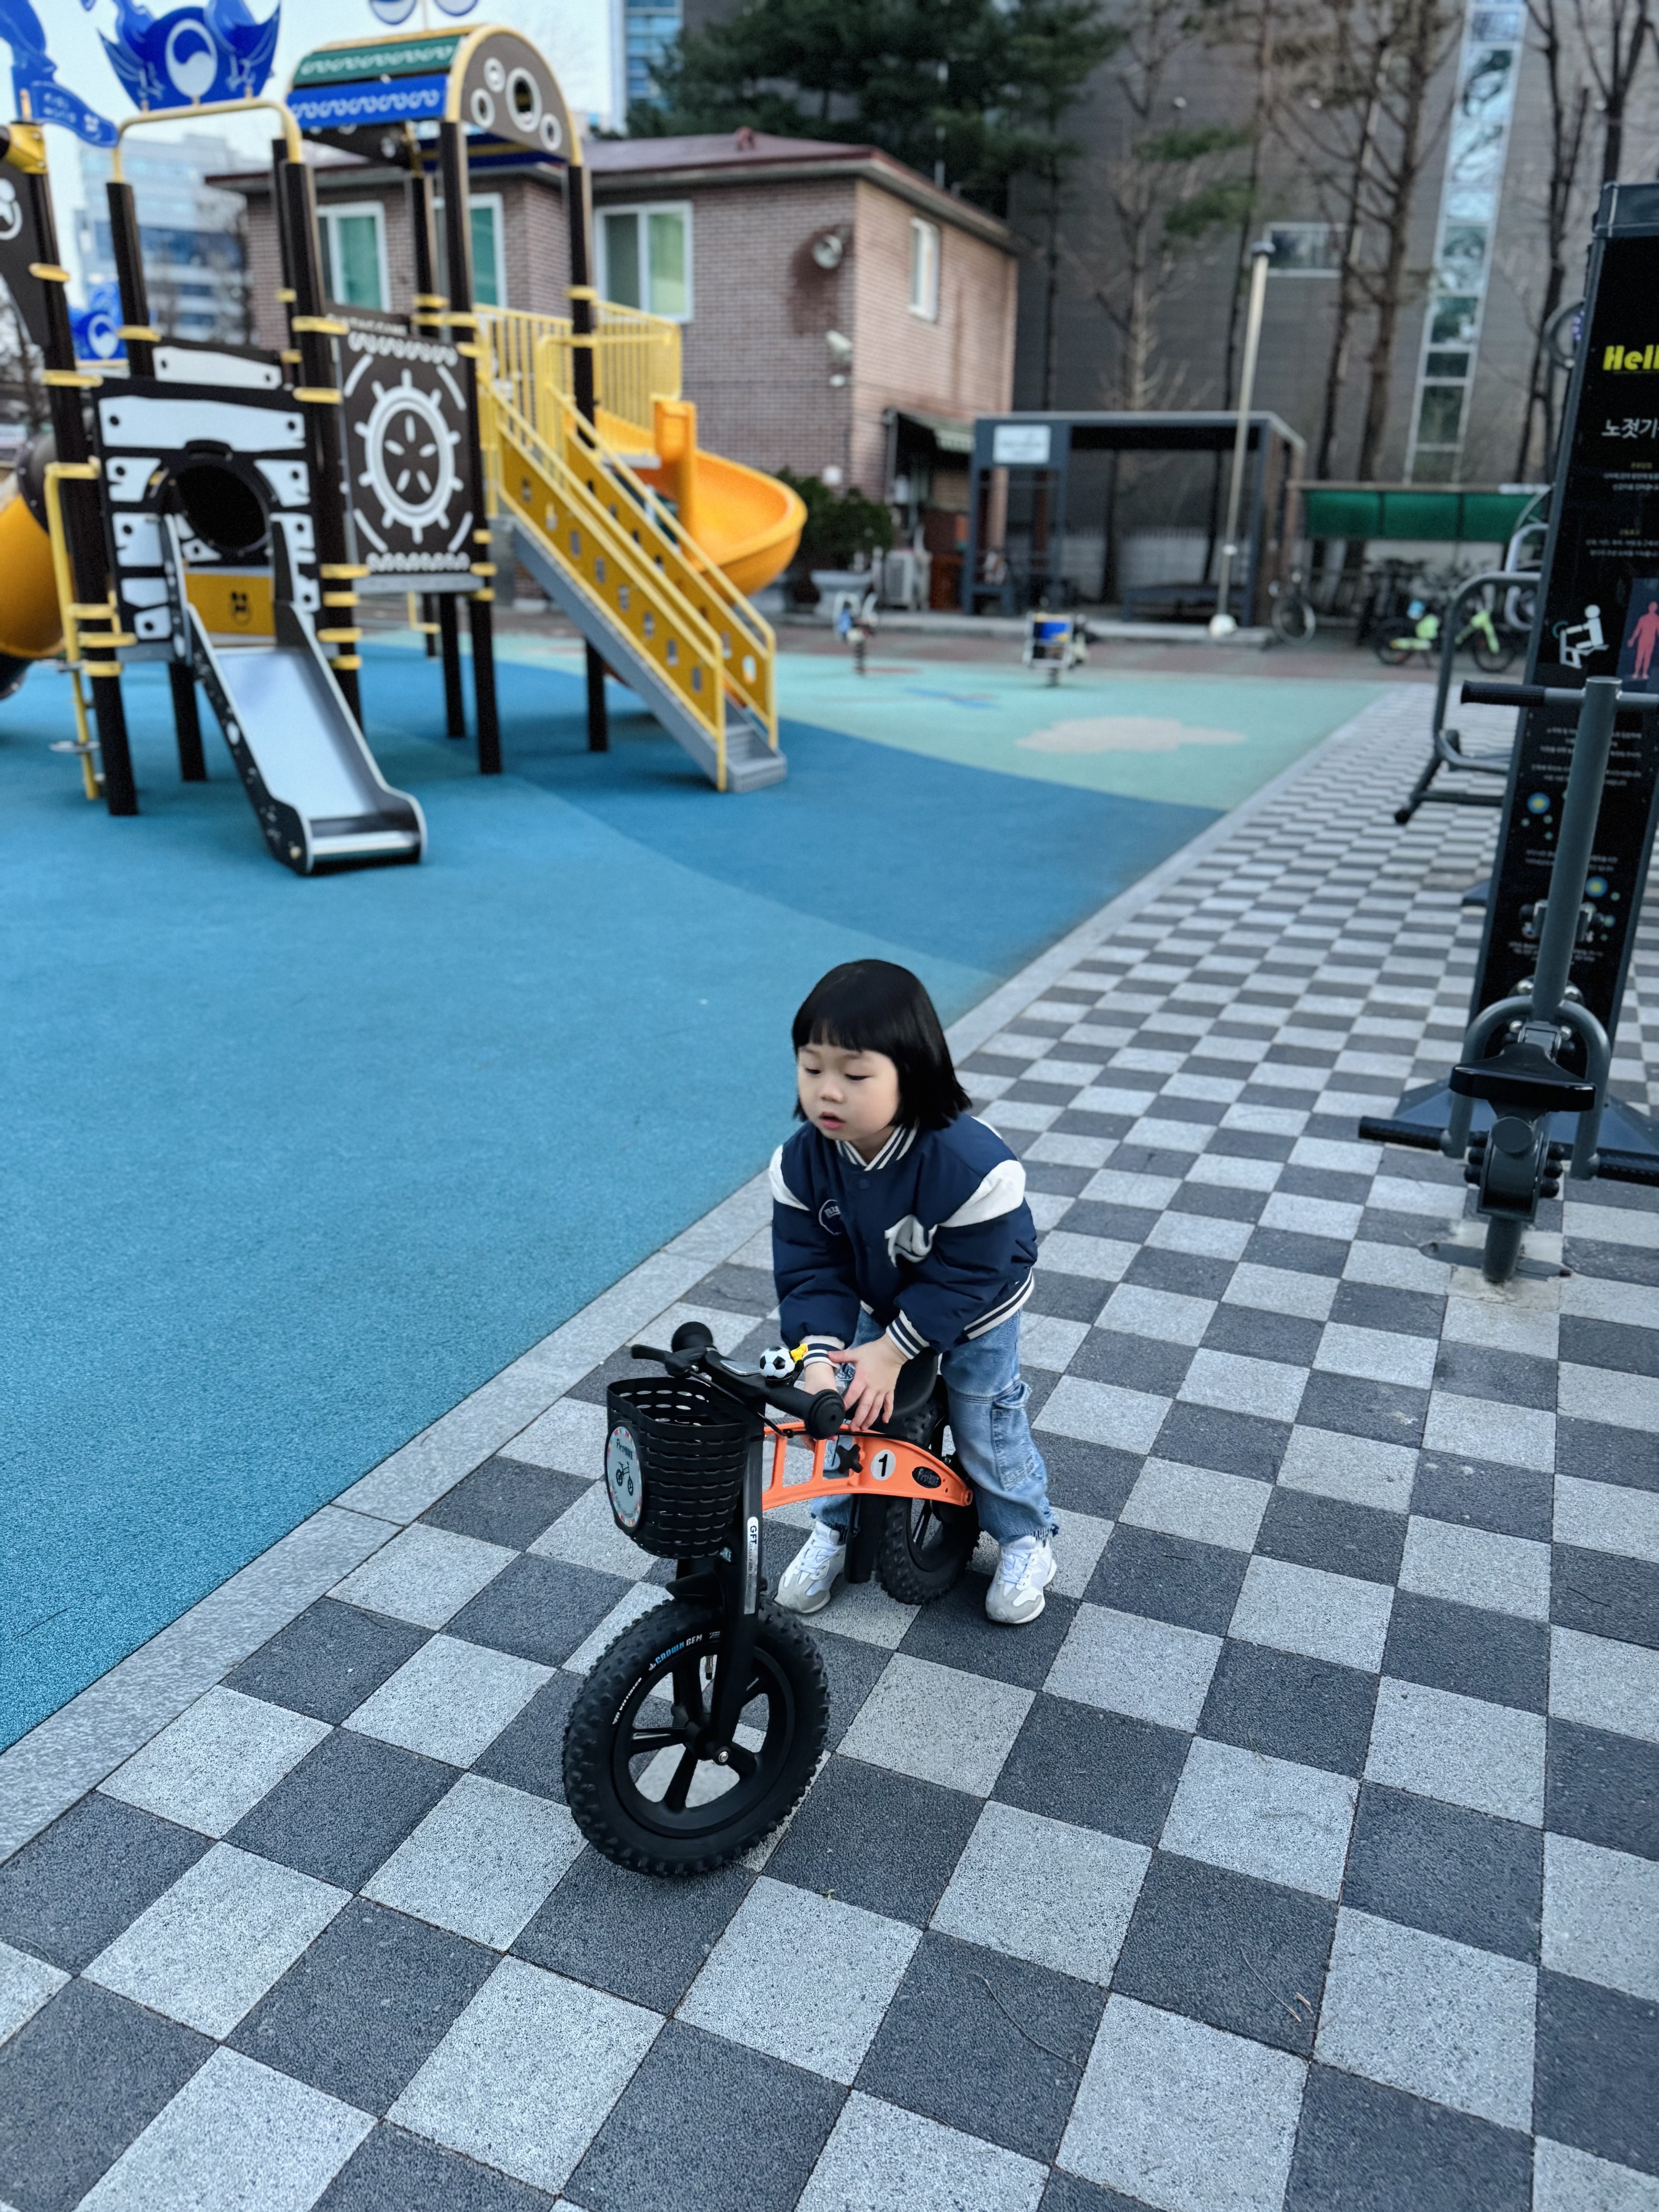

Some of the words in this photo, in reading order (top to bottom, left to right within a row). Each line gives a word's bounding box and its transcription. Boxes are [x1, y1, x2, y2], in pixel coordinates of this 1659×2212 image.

[1601, 417, 1659, 439] 노젓기
[879, 1454, 888, 1477] 1
[655, 1642, 684, 1664] CROWN
[686, 1634, 702, 1646] GEM
